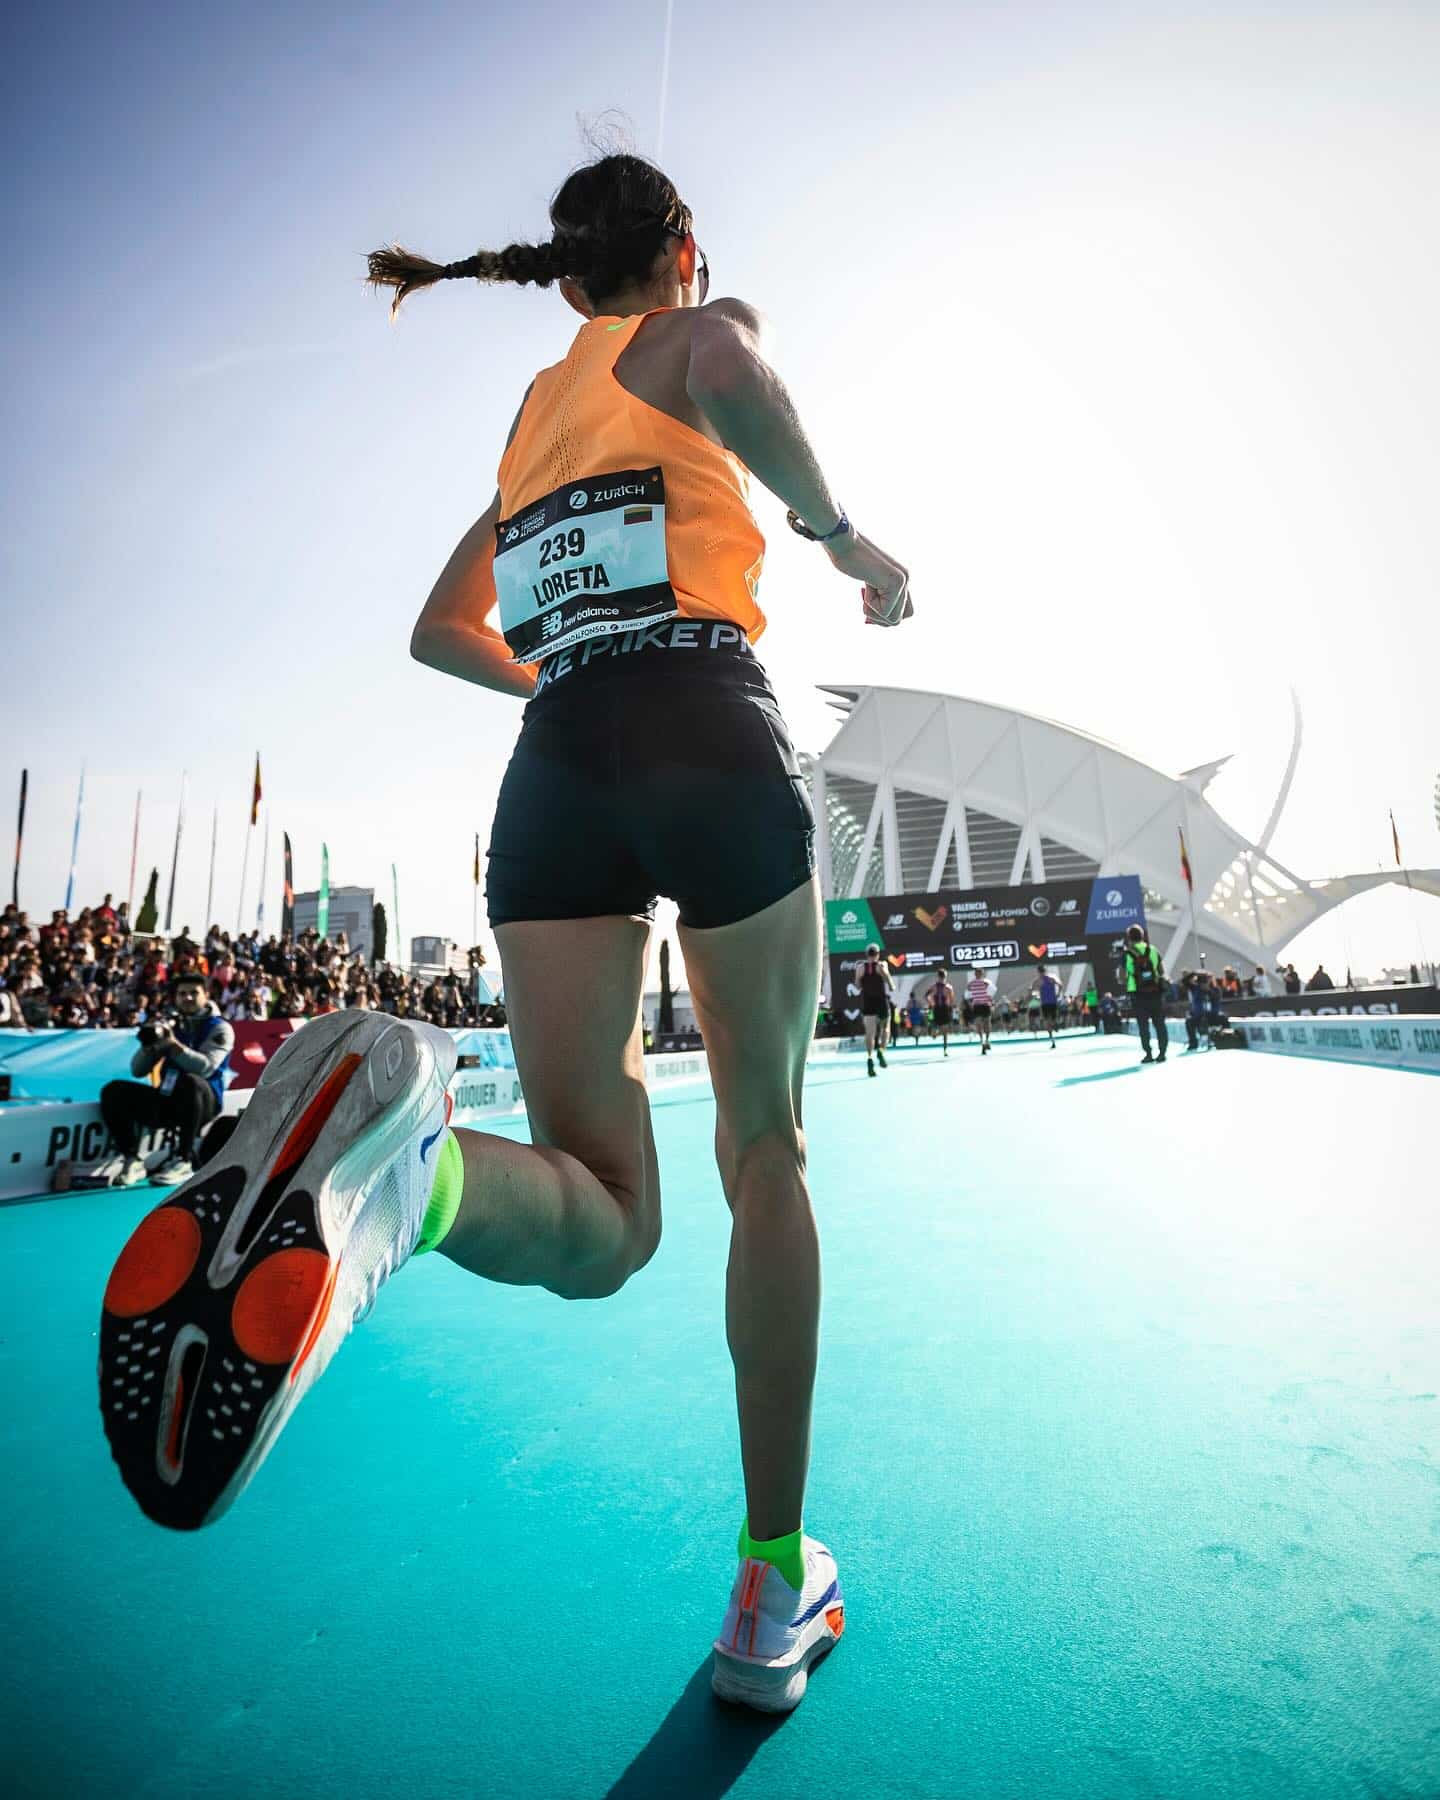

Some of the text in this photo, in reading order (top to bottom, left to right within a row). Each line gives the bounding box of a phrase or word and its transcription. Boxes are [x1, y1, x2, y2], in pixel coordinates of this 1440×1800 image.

[594, 484, 645, 503] ZURICH
[539, 528, 585, 569] 239
[532, 563, 610, 608] LORETA
[564, 607, 620, 629] new balance
[952, 908, 1029, 921] TRINIDAD ALFONSO
[1096, 908, 1138, 920] ZURICH
[956, 944, 1013, 960] 02:31:10
